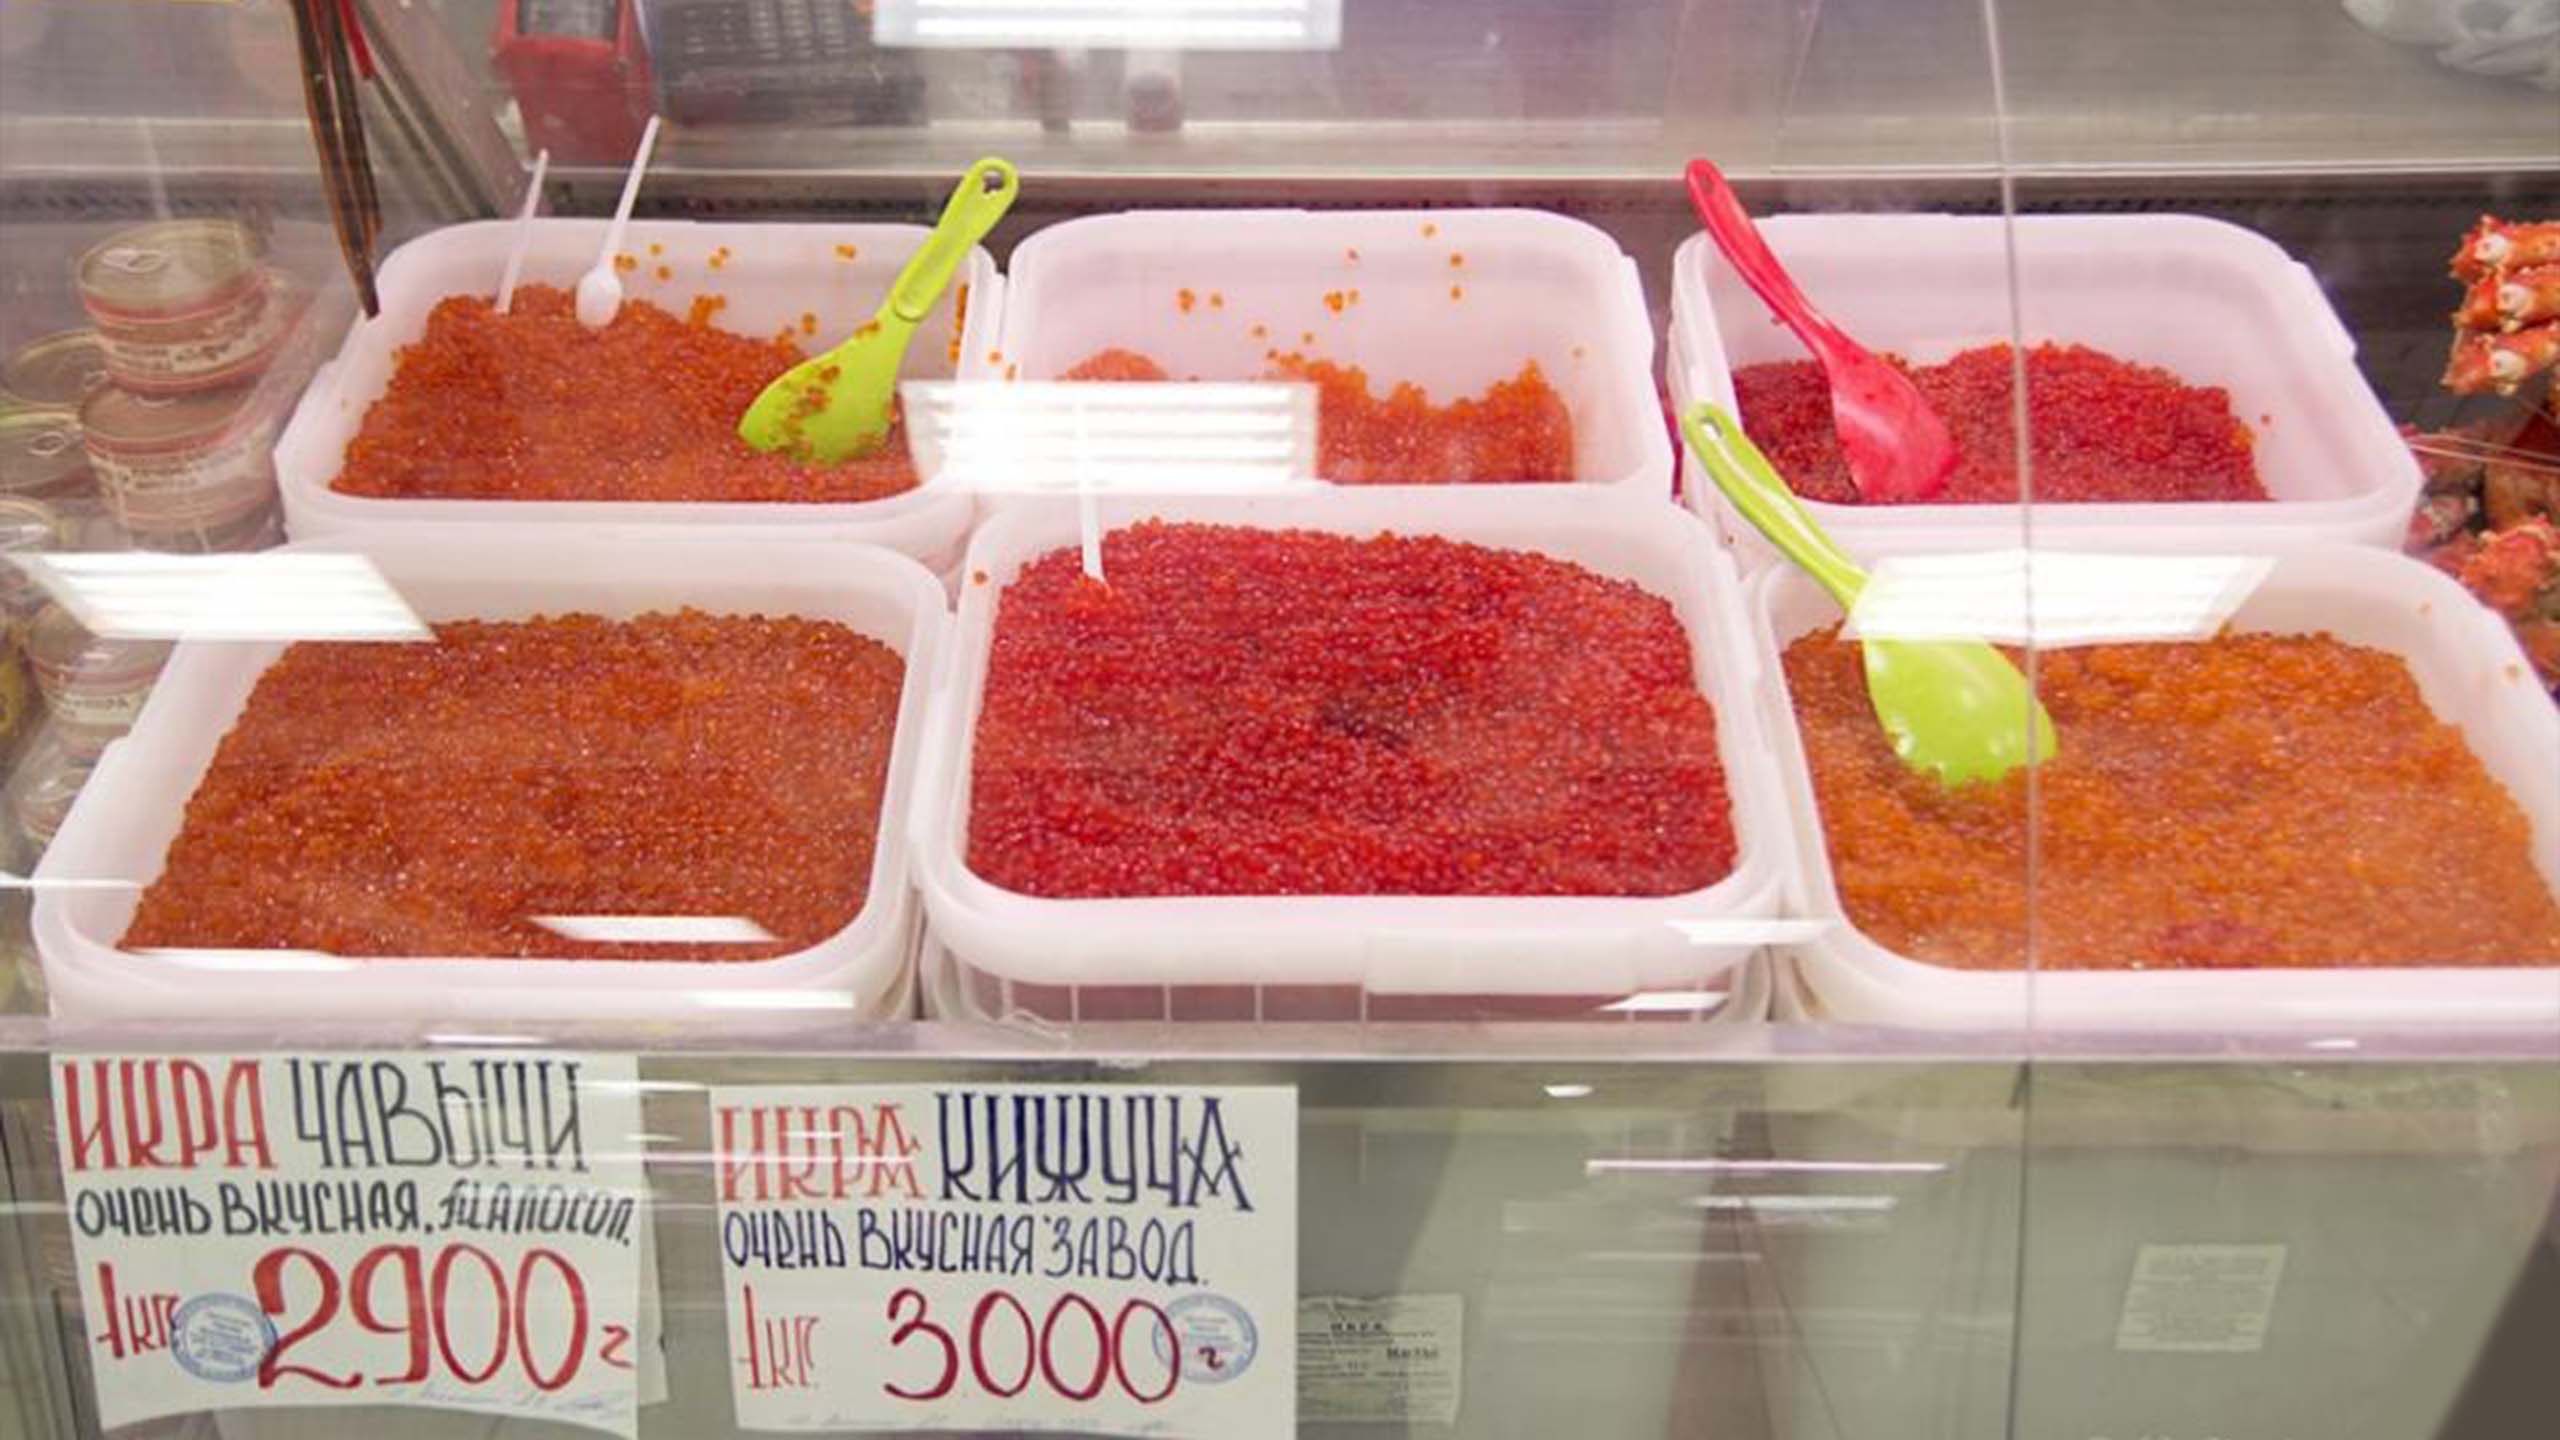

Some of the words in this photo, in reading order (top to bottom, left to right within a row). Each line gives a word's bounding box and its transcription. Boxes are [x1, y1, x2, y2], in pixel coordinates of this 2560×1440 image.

[60, 1057, 277, 1170] ИКРА
[284, 1057, 586, 1172] ЧАВЫЧИ
[718, 1104, 927, 1202] ИКРА
[935, 1091, 1254, 1212] КИЖУЧА
[75, 1184, 211, 1238] ОЧЕНЬ
[723, 1209, 846, 1270] ОЧЕНЬ
[251, 1244, 589, 1391] 2900
[883, 1287, 1182, 1404] 3000
